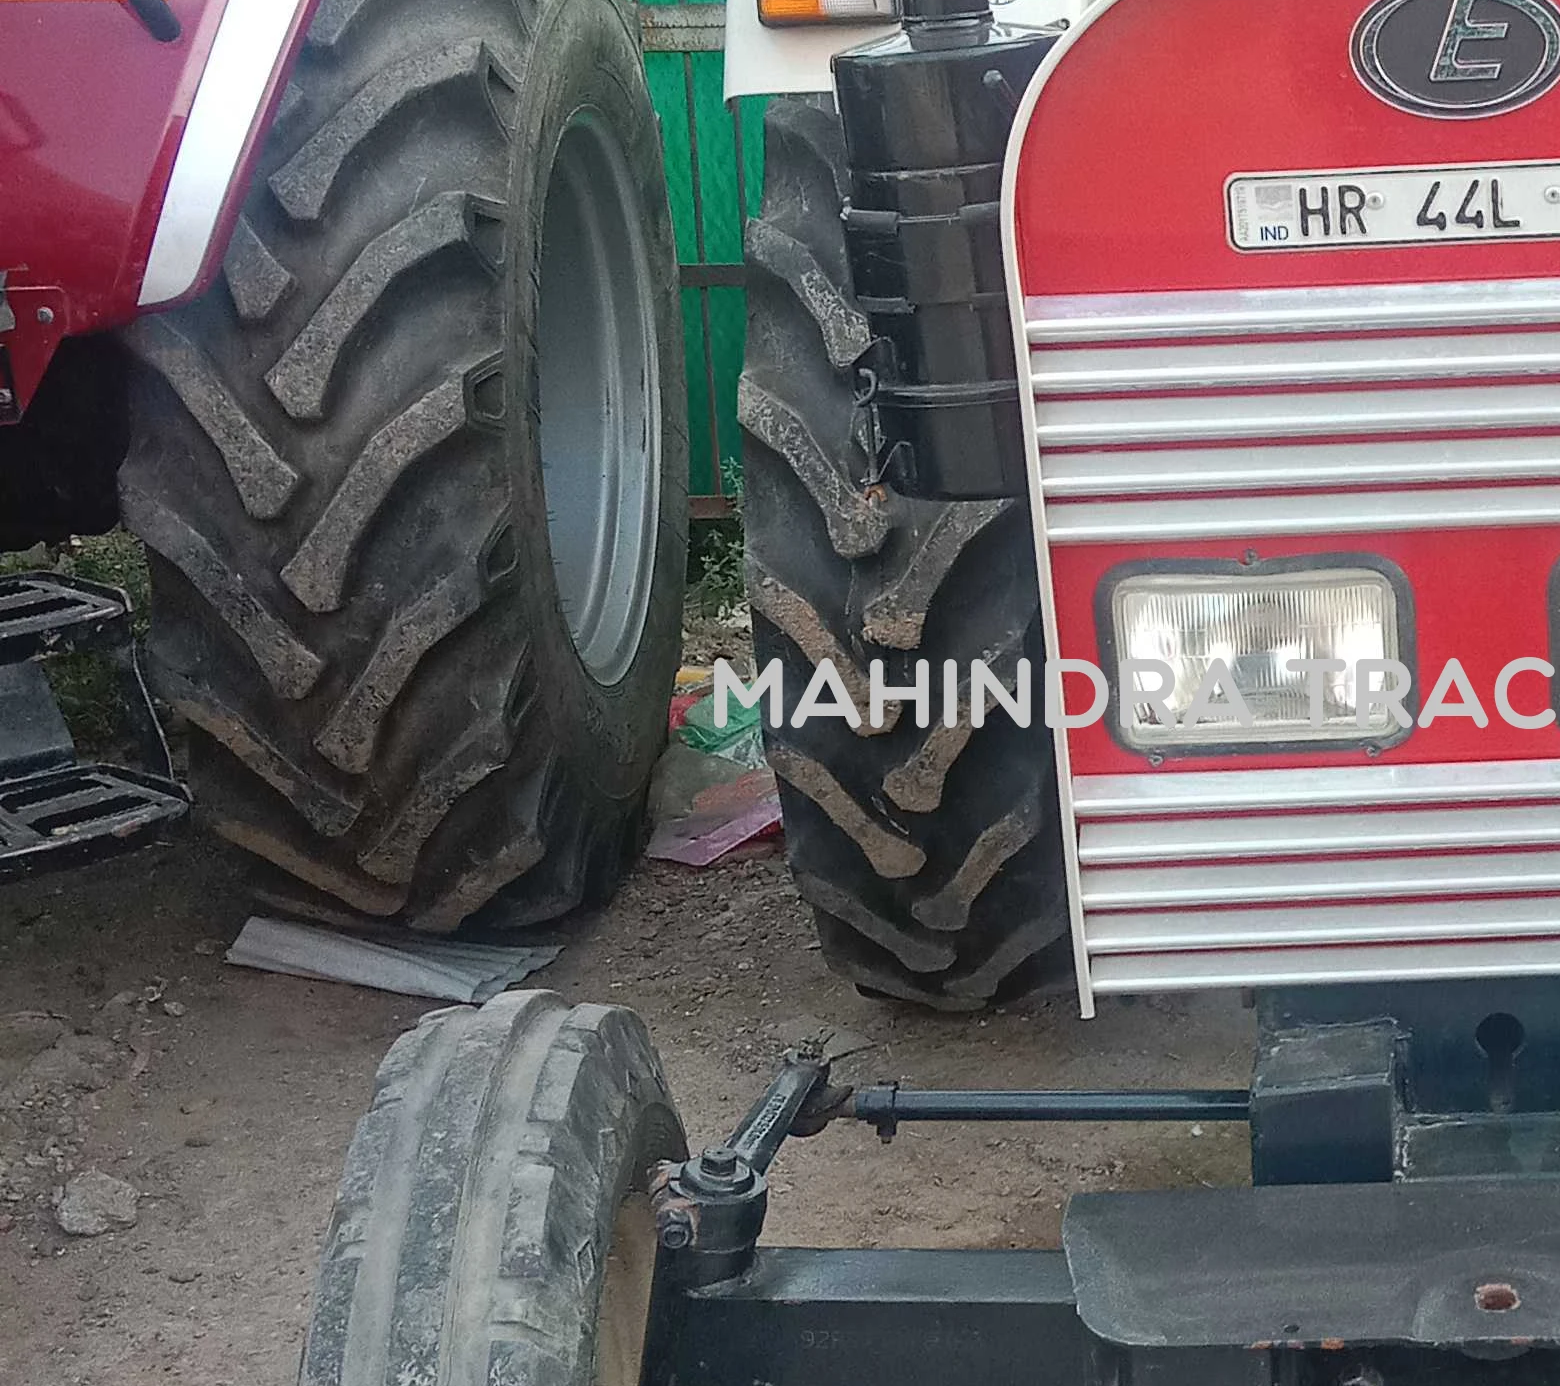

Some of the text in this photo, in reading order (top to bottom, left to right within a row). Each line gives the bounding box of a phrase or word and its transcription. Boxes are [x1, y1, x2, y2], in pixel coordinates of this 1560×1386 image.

[1298, 185, 1367, 236] HR
[1416, 179, 1520, 231] 44L
[1260, 225, 1289, 241] IND
